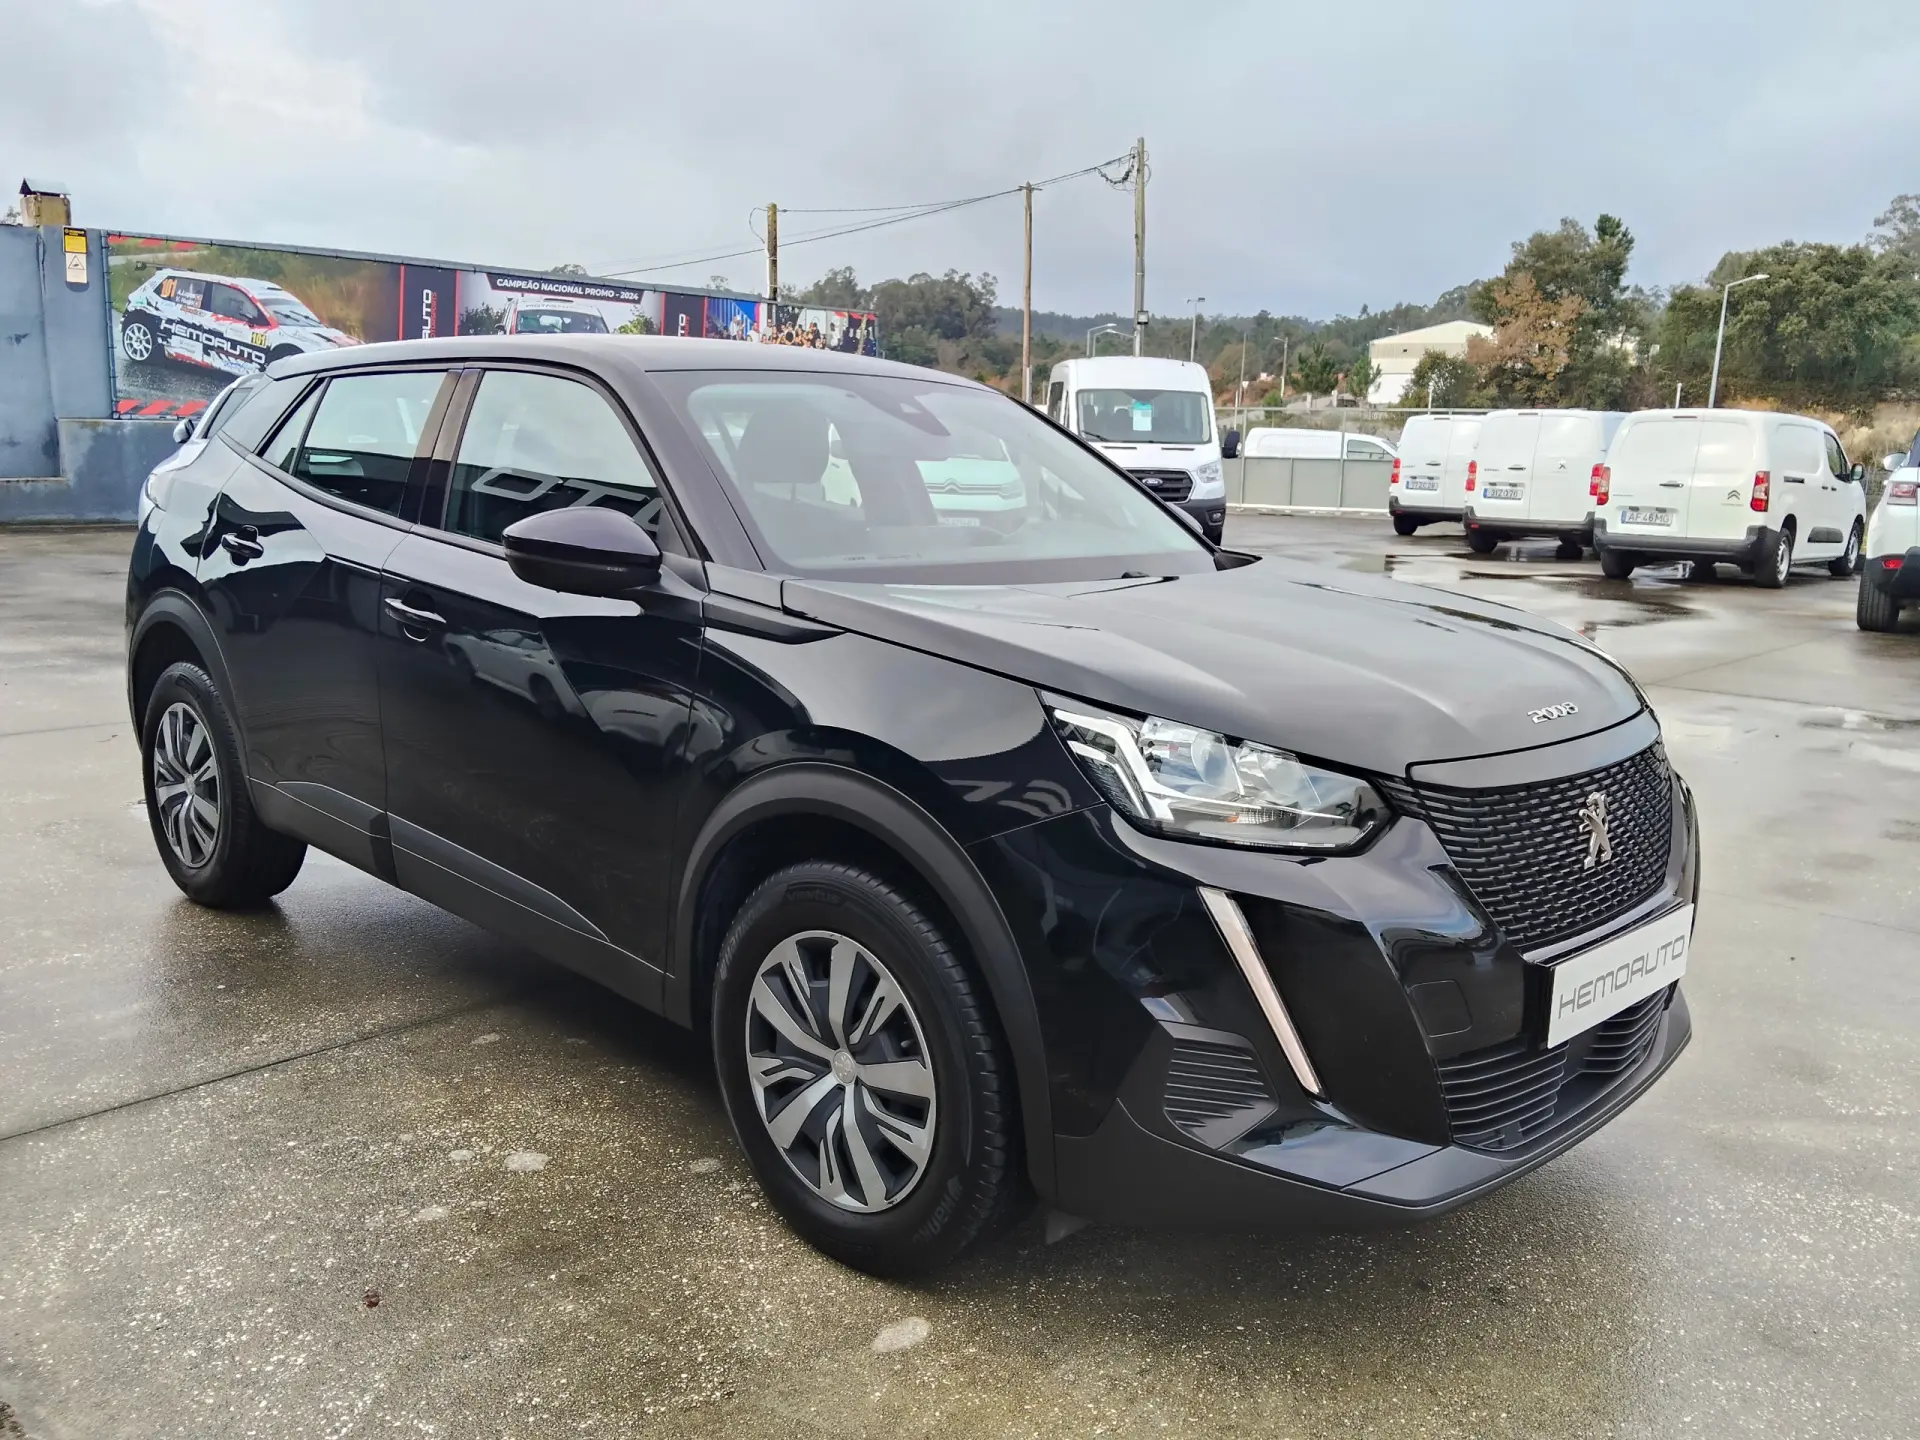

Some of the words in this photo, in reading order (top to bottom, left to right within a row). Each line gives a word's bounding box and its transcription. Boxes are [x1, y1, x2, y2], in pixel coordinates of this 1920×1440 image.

[160, 278, 177, 298] 101
[496, 278, 540, 290] CAMPEÃO
[541, 283, 584, 295] NACIONAL
[585, 289, 615, 298] PROMO
[620, 291, 640, 300] 2024
[160, 319, 266, 364] HEMOAUTO
[1527, 701, 1579, 724] 2008
[1557, 934, 1685, 1019] HEMOAUTO
